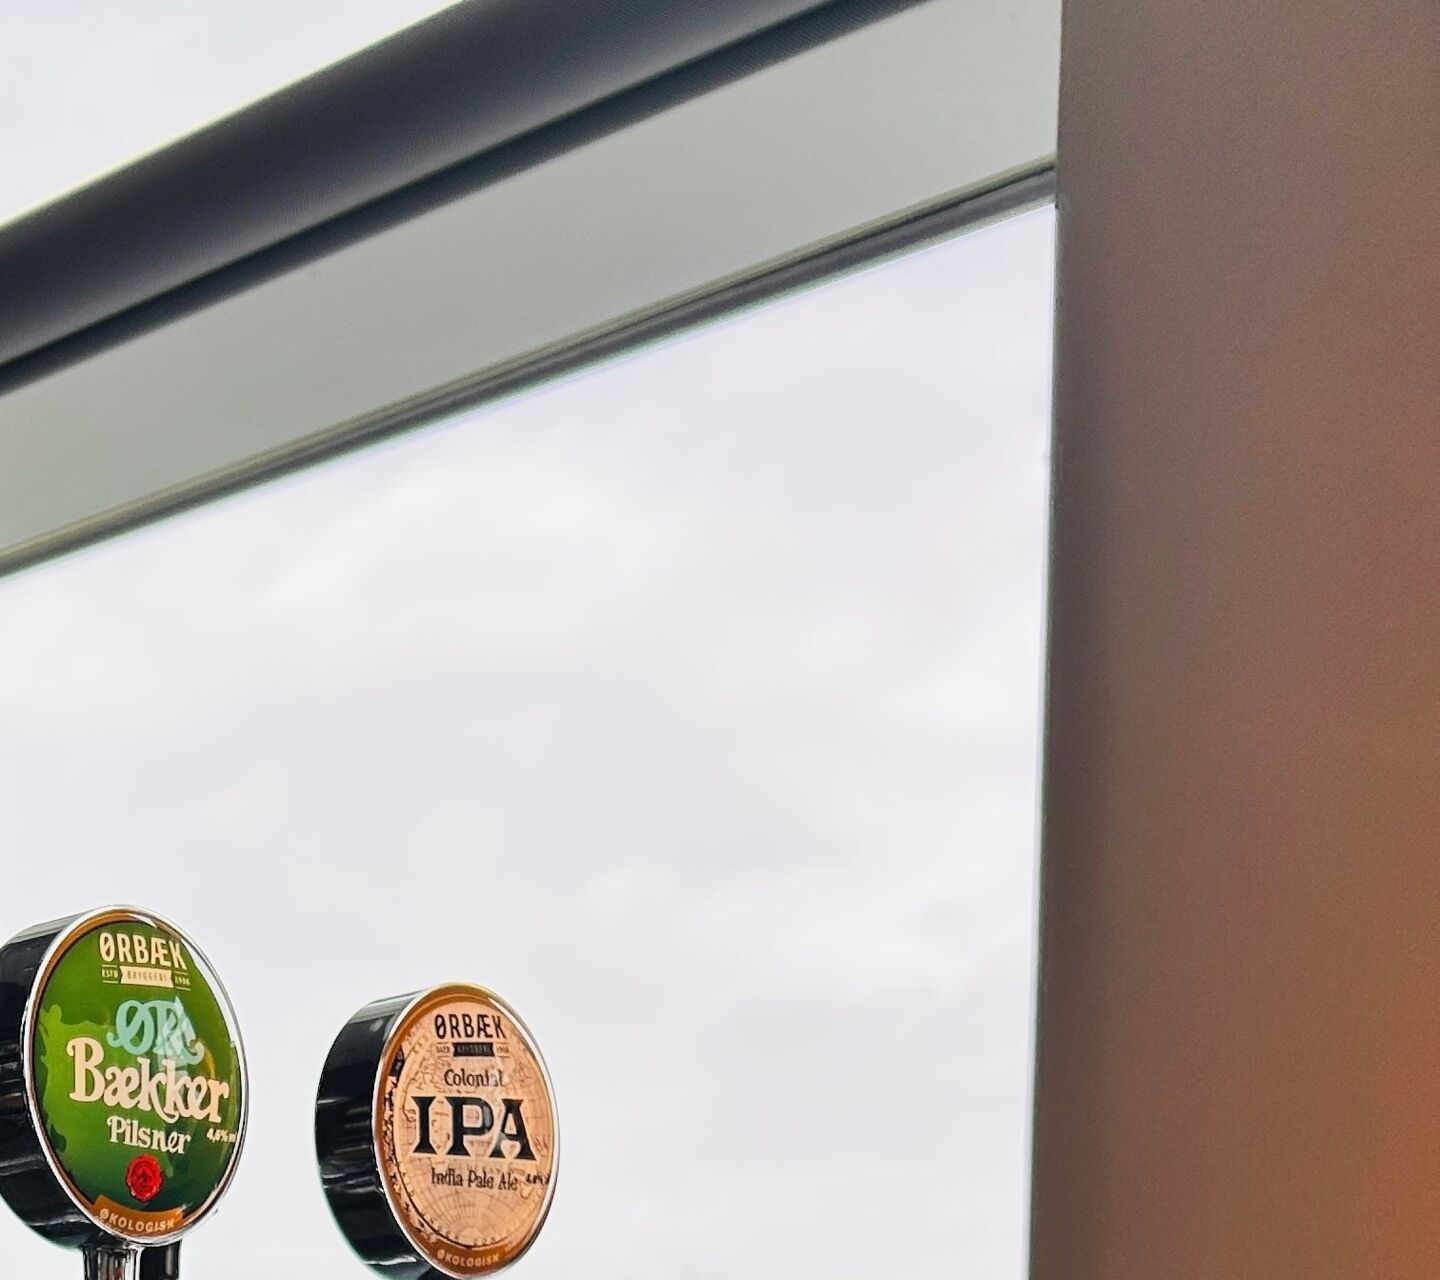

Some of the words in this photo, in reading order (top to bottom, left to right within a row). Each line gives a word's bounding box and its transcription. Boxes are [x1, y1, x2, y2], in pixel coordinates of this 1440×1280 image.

[99, 932, 187, 970] ØRBÆK
[434, 1013, 507, 1039] ØRBÆK
[66, 1036, 230, 1124] Bækker
[107, 1115, 192, 1154] Pilsner
[411, 1096, 537, 1161] IPA
[431, 1167, 463, 1187] India
[467, 1169, 494, 1189] Pale
[498, 1171, 518, 1191] Ale
[99, 1208, 175, 1233] ØKOLOGISK
[437, 1249, 500, 1268] ØKOLOGISK
